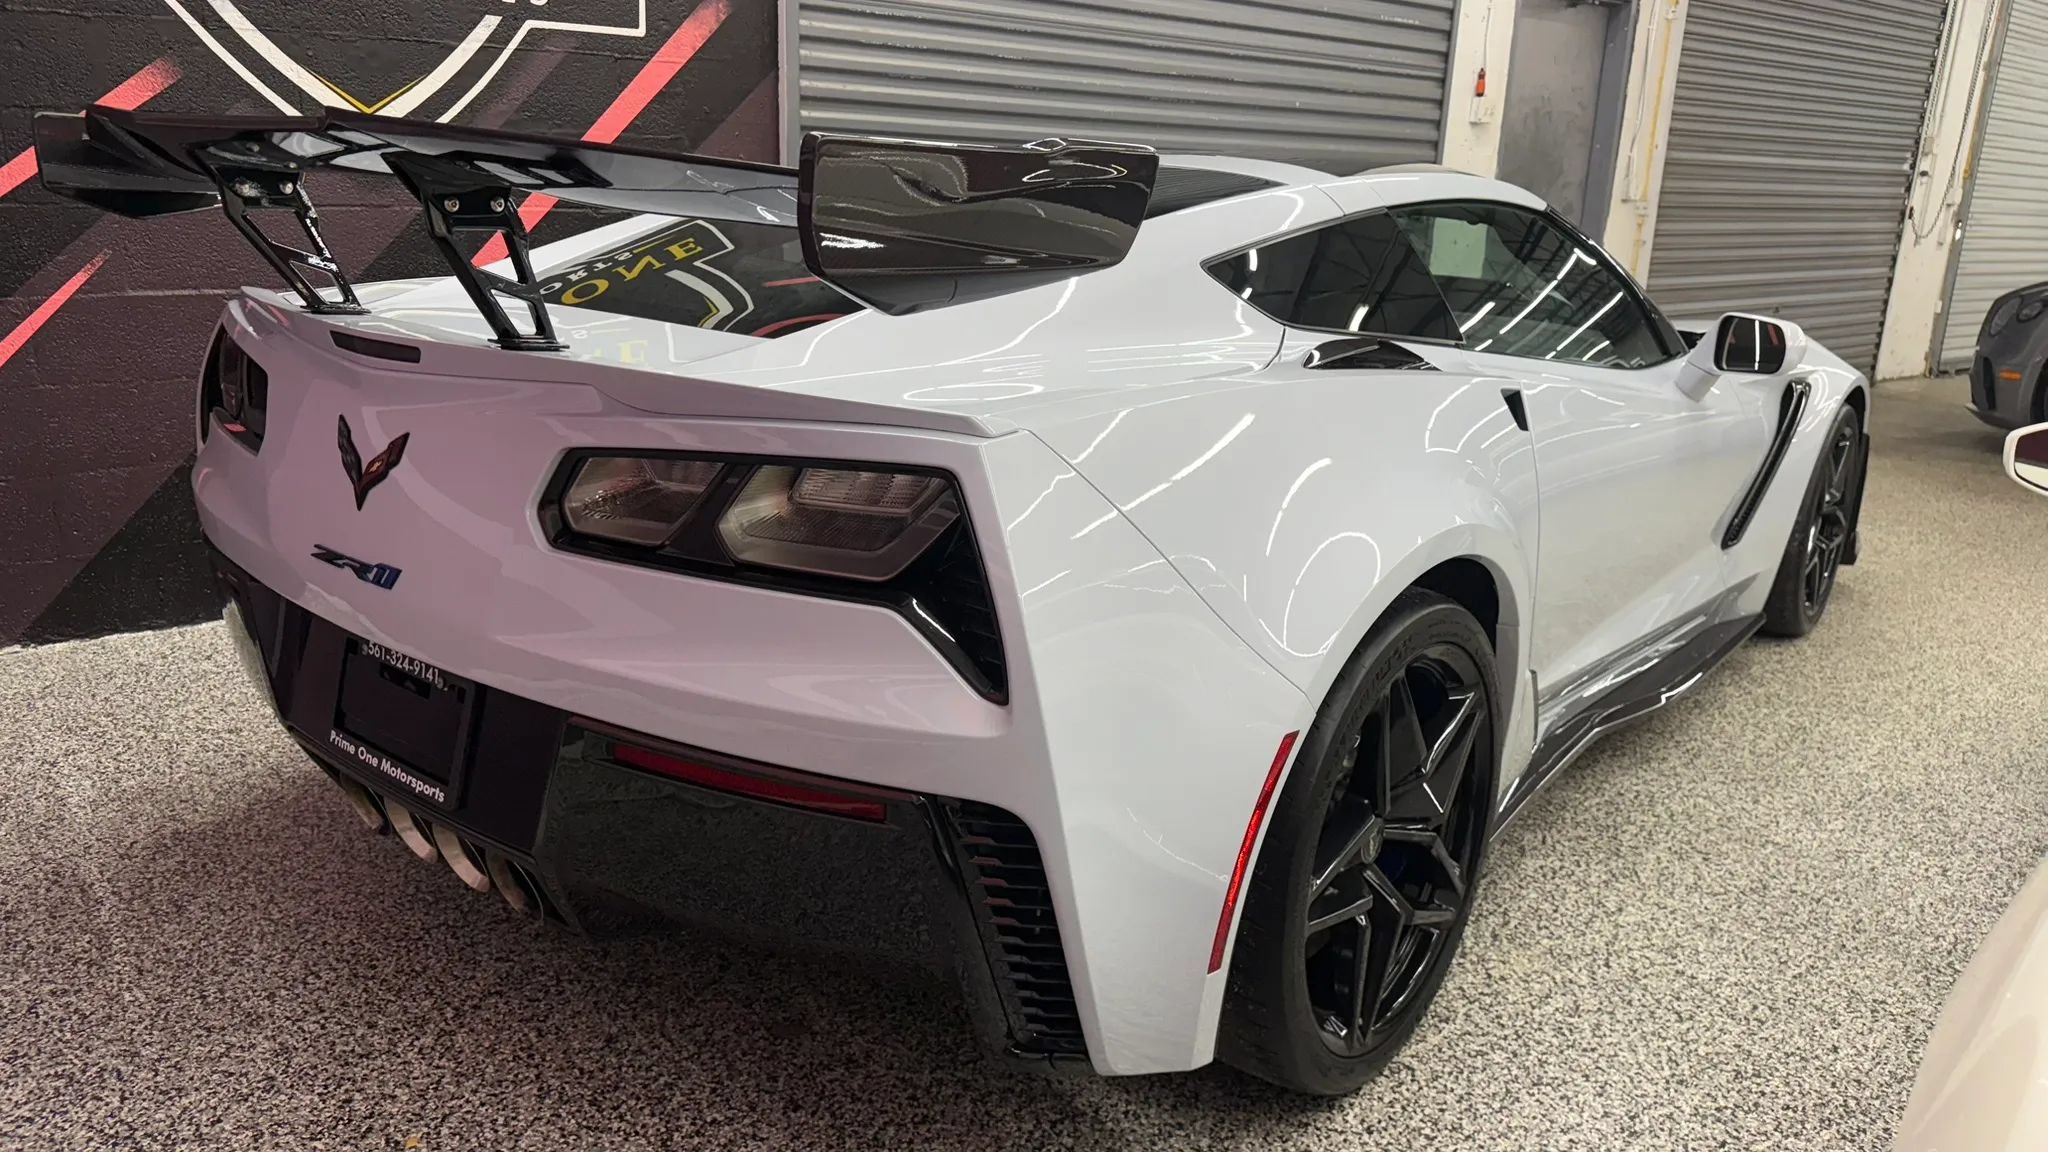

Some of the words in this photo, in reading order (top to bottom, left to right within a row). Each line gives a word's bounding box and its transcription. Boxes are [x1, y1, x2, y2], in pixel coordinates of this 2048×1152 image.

[368, 642, 439, 685] 561-324-9141
[329, 730, 356, 755] Prime
[357, 746, 379, 768] One
[380, 758, 445, 803] Motorsports
